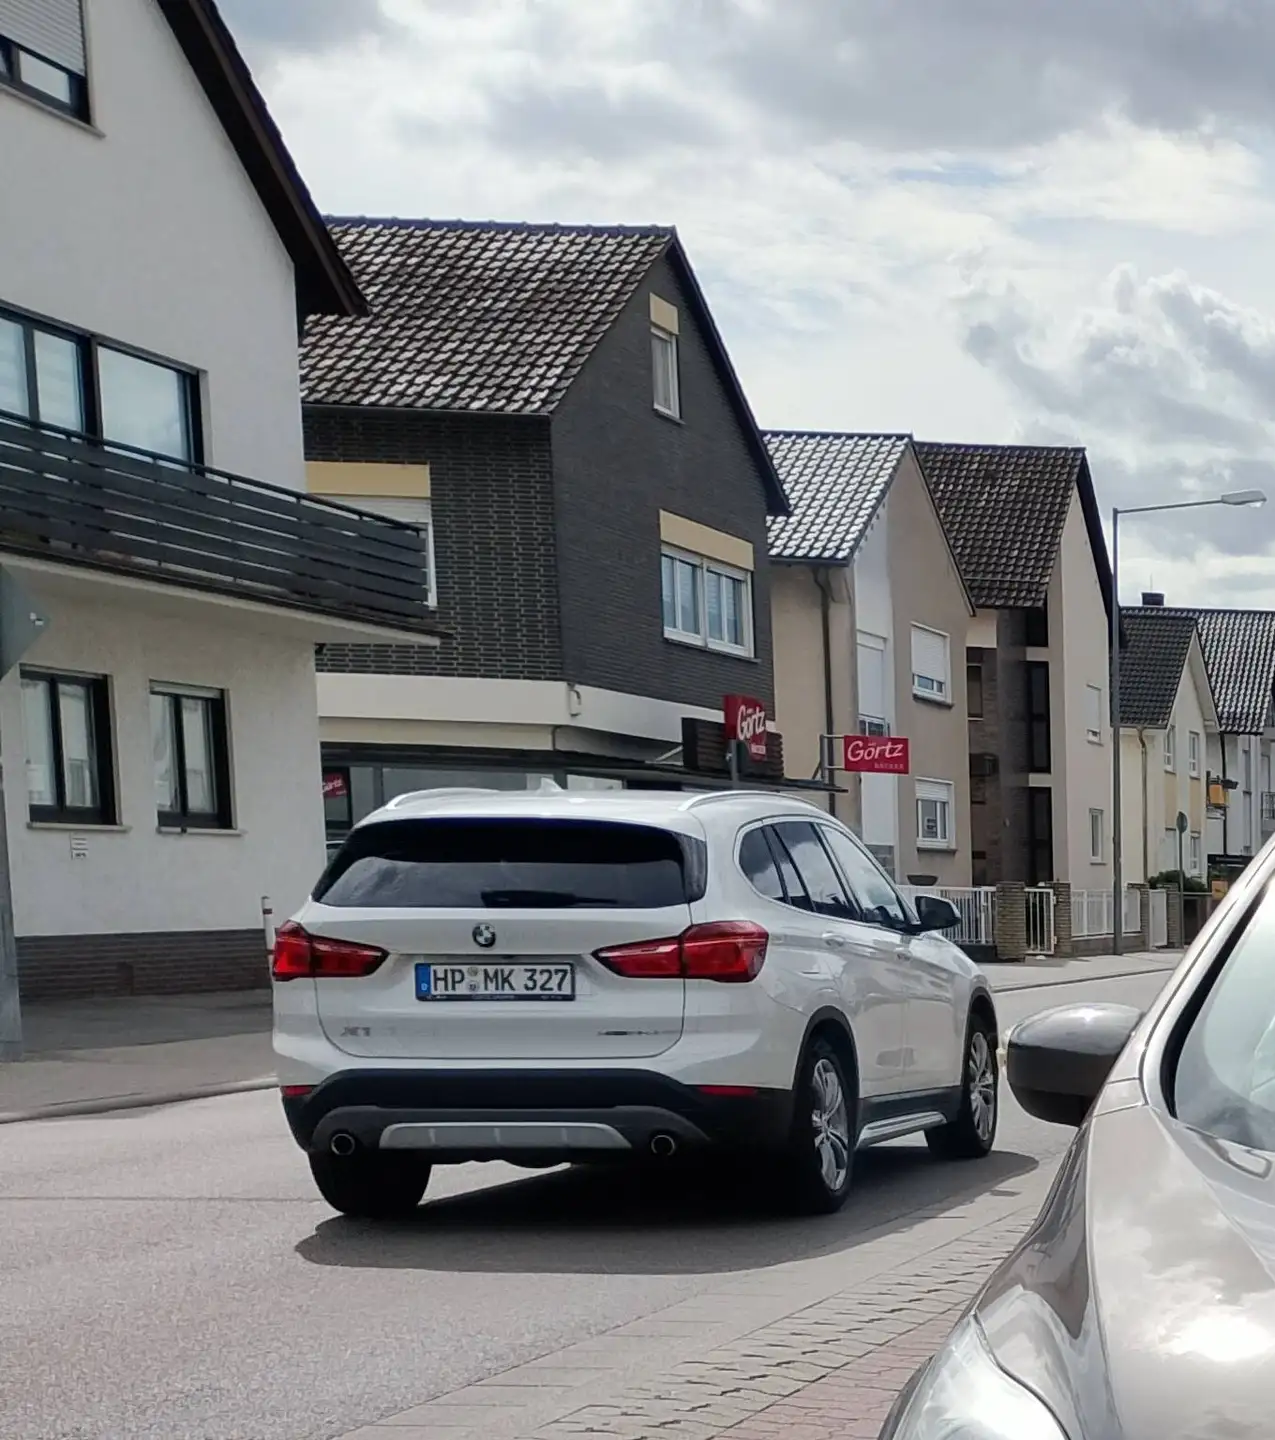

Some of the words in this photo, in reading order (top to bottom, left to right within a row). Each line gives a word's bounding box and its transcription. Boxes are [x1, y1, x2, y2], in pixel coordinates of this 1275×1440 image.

[737, 704, 765, 740] Görtz
[847, 740, 904, 761] Görtz
[433, 969, 465, 991] HP
[484, 969, 516, 991] MK
[523, 969, 569, 992] 327
